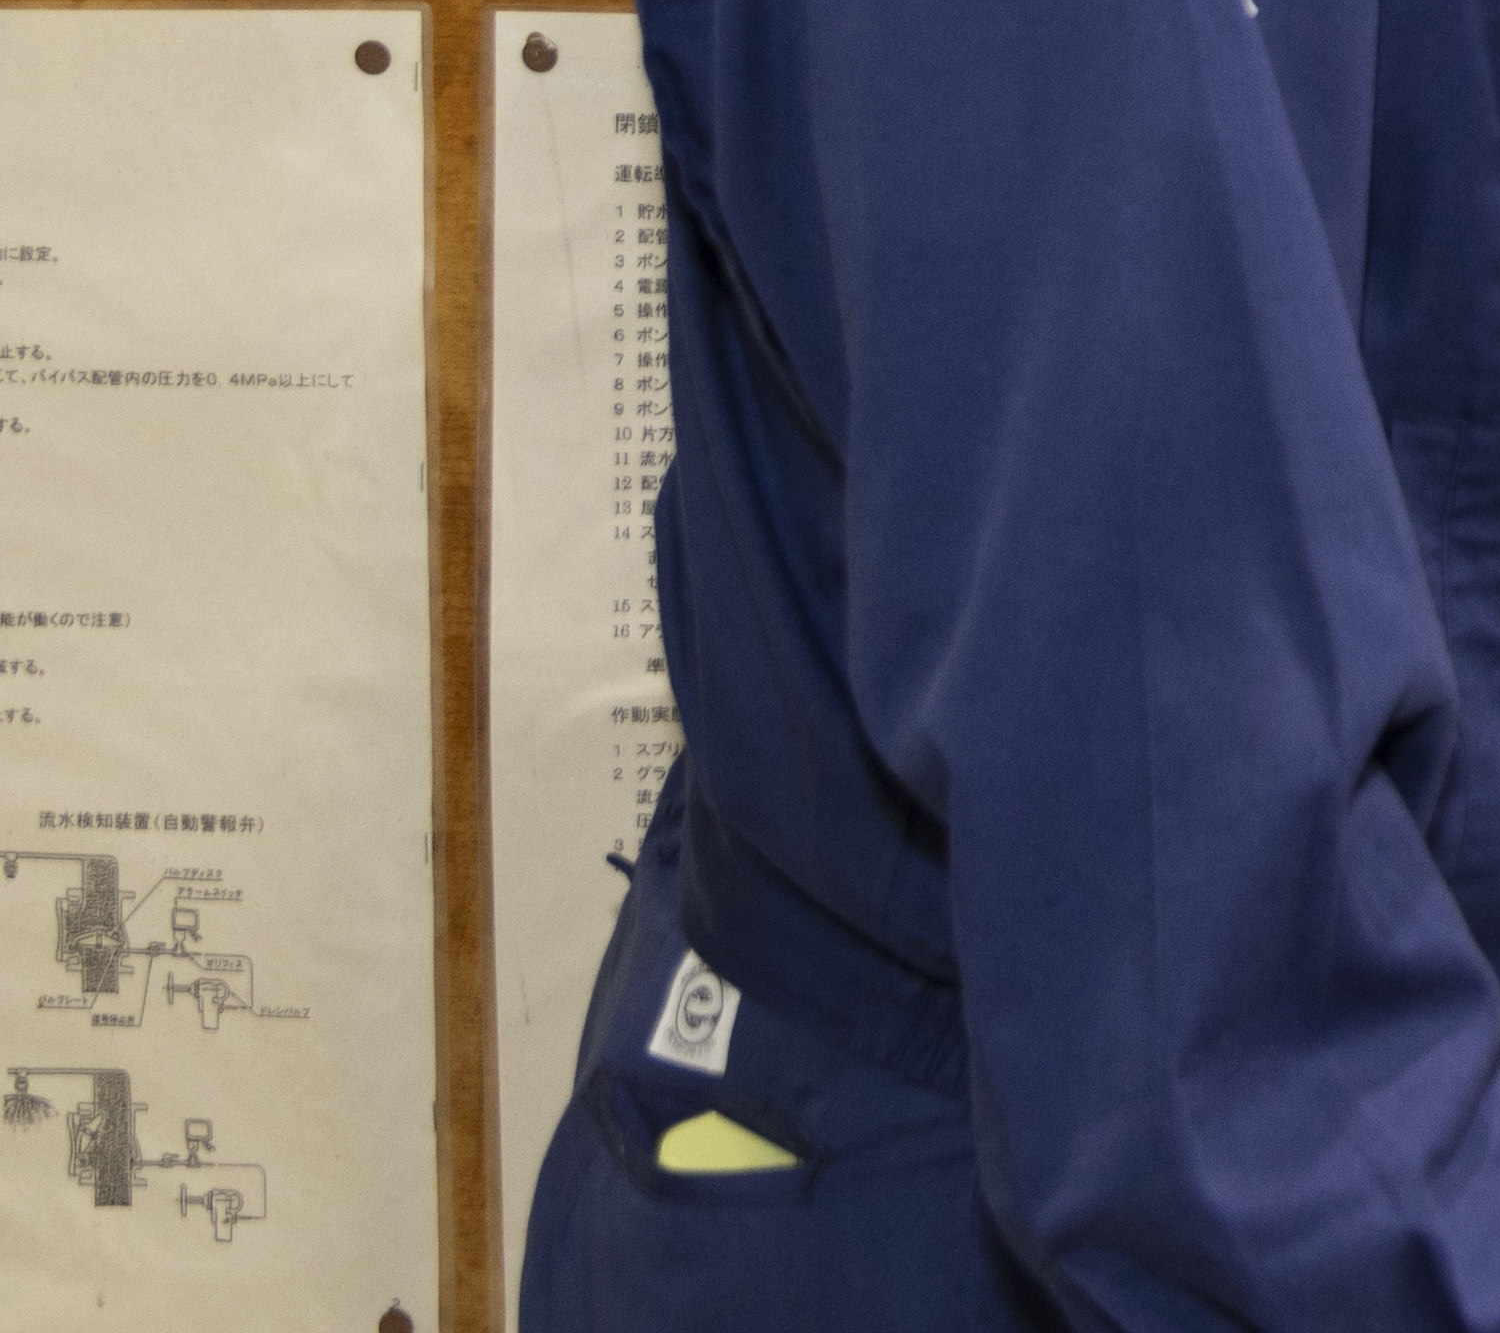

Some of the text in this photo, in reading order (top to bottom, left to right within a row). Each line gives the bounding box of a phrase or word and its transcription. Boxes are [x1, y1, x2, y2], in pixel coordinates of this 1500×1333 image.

[616, 205, 623, 218] 1
[615, 229, 625, 244] 2
[614, 254, 625, 269] 3
[614, 279, 624, 293] 4
[614, 303, 625, 318] 5
[613, 328, 625, 342] 6
[614, 353, 624, 367] 7
[613, 377, 625, 391] 8
[613, 402, 625, 417] 9
[614, 427, 632, 442] 10
[613, 451, 630, 466] 11
[613, 476, 632, 491] 12
[613, 501, 632, 515] 13
[613, 526, 631, 540] 14
[613, 599, 631, 613] 15
[612, 624, 631, 639] 16
[613, 744, 621, 757] 1
[613, 767, 624, 781] 2
[39, 811, 265, 833] 流水検知装置(自動警報弁)
